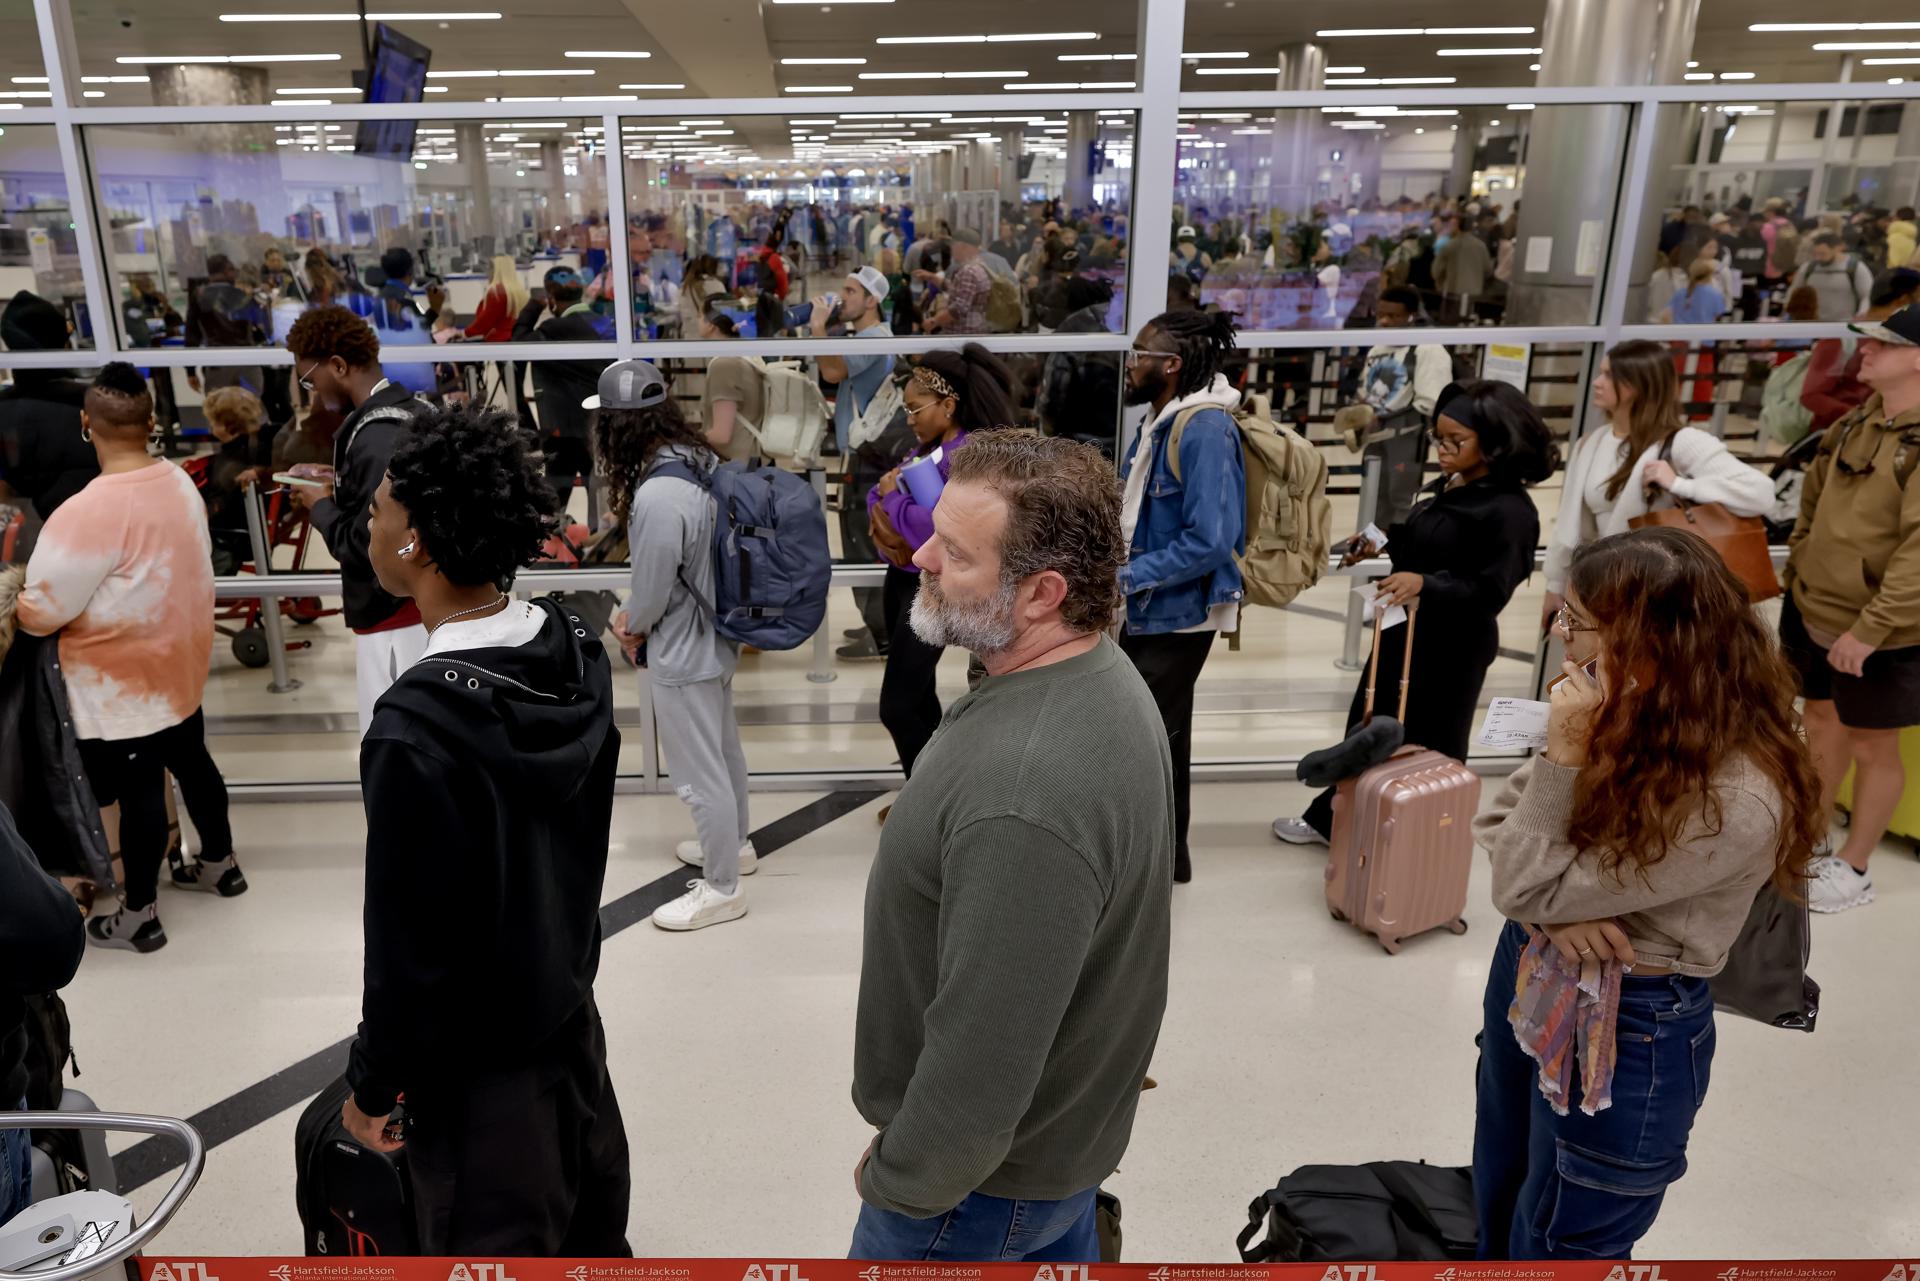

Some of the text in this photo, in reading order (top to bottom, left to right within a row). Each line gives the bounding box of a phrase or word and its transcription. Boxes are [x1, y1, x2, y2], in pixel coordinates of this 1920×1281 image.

[150, 1263, 219, 1281] ATL
[294, 1266, 395, 1275] Hartsfield-Jackson
[447, 1263, 516, 1281] ATL
[590, 1266, 690, 1276] Hartsfield-Jackson
[742, 1264, 809, 1281] ATL
[883, 1267, 982, 1276] Hartsfield-Jackson
[1033, 1264, 1099, 1281] ATL
[1172, 1267, 1270, 1277] Hartsfield-Jackson
[1320, 1265, 1385, 1281] ATL
[1458, 1269, 1555, 1278] Hartsfield-Jackson
[1603, 1265, 1668, 1281] ATL
[1741, 1268, 1837, 1277] Hartsfield-Jackson
